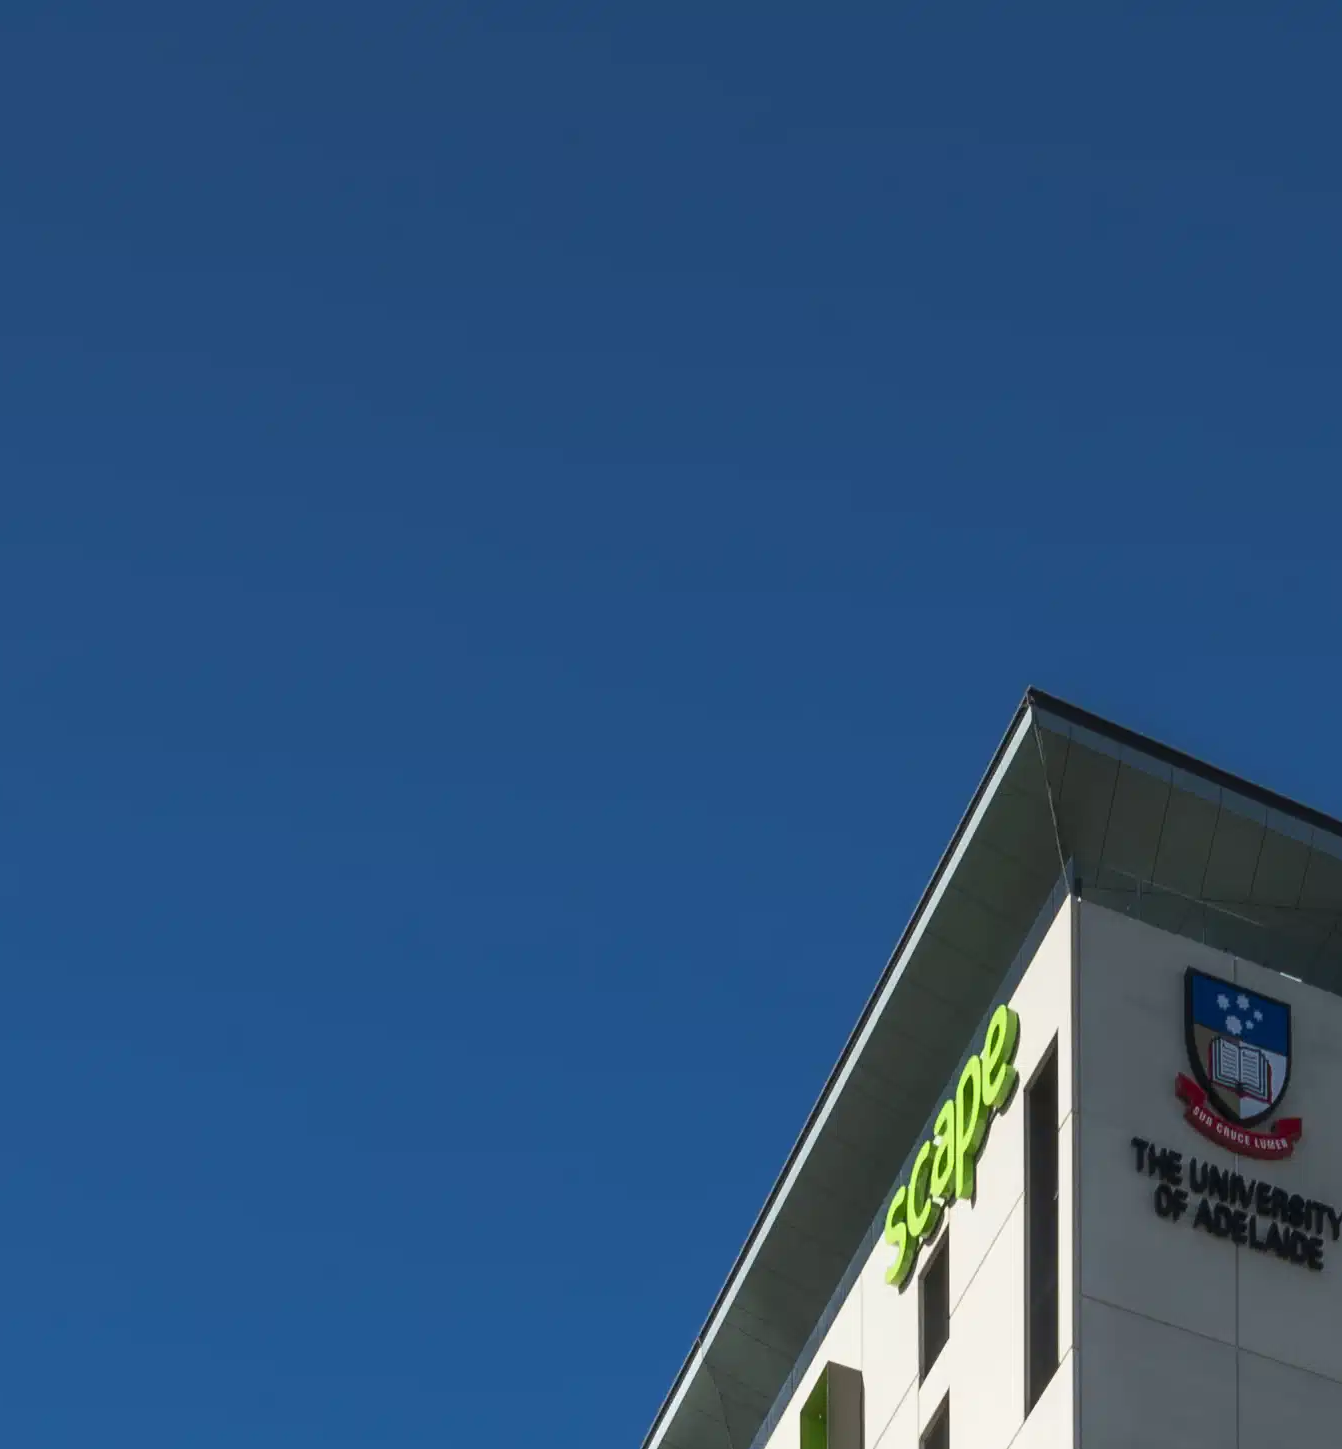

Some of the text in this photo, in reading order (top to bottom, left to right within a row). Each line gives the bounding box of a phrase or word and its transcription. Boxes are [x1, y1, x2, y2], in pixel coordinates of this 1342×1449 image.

[885, 1003, 1018, 1286] scape
[1131, 1136, 1183, 1185] THE
[1154, 1183, 1325, 1271] OF ADELAIDE
